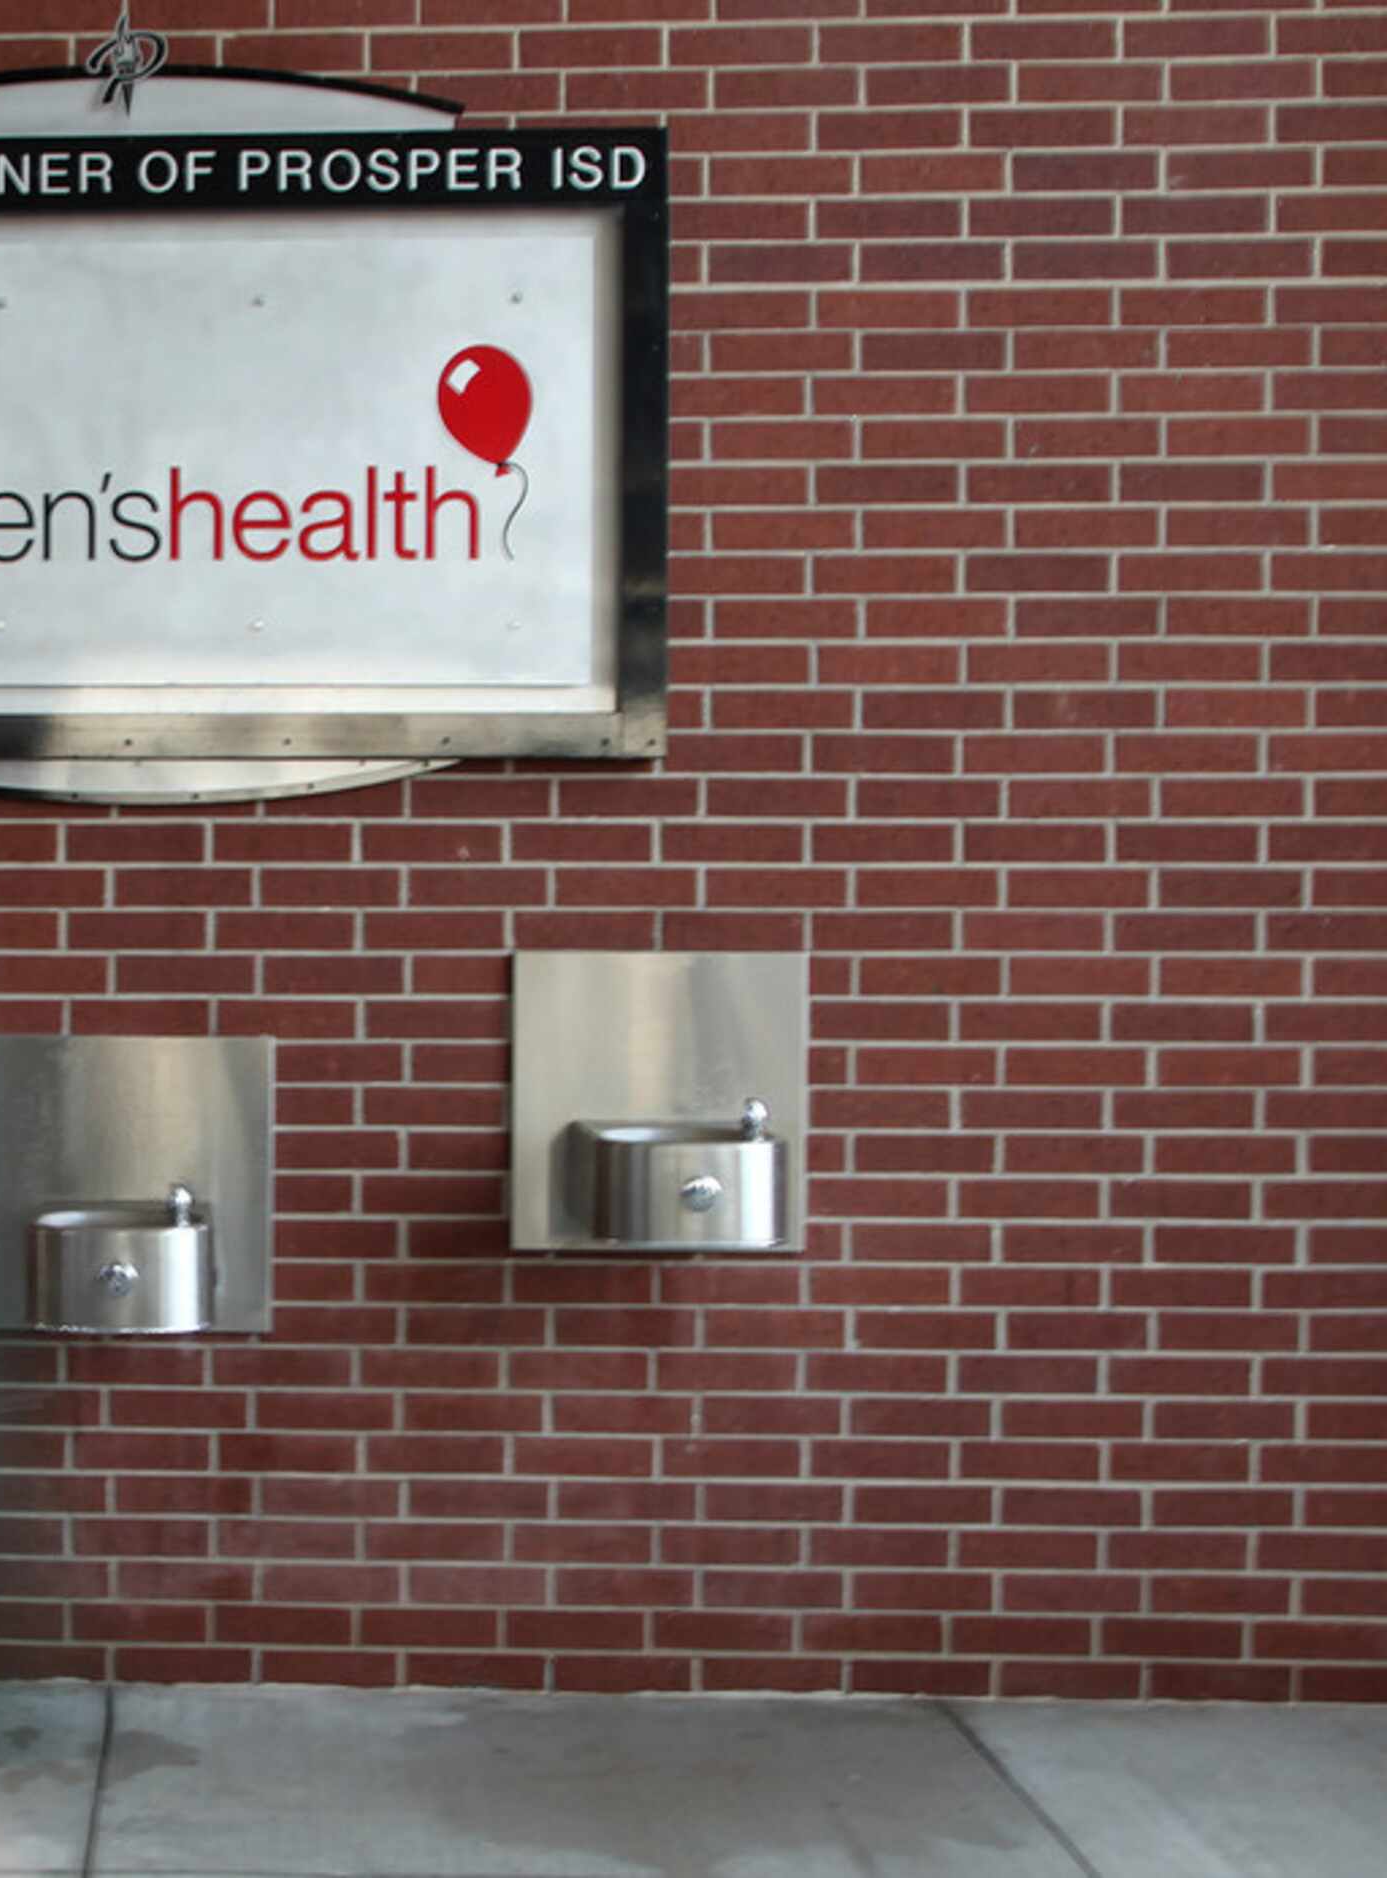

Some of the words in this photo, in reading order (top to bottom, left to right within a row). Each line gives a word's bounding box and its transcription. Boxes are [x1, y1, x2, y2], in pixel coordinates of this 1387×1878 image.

[137, 149, 217, 194] OF
[238, 146, 524, 194] PROSPER
[552, 144, 648, 191] ISD
